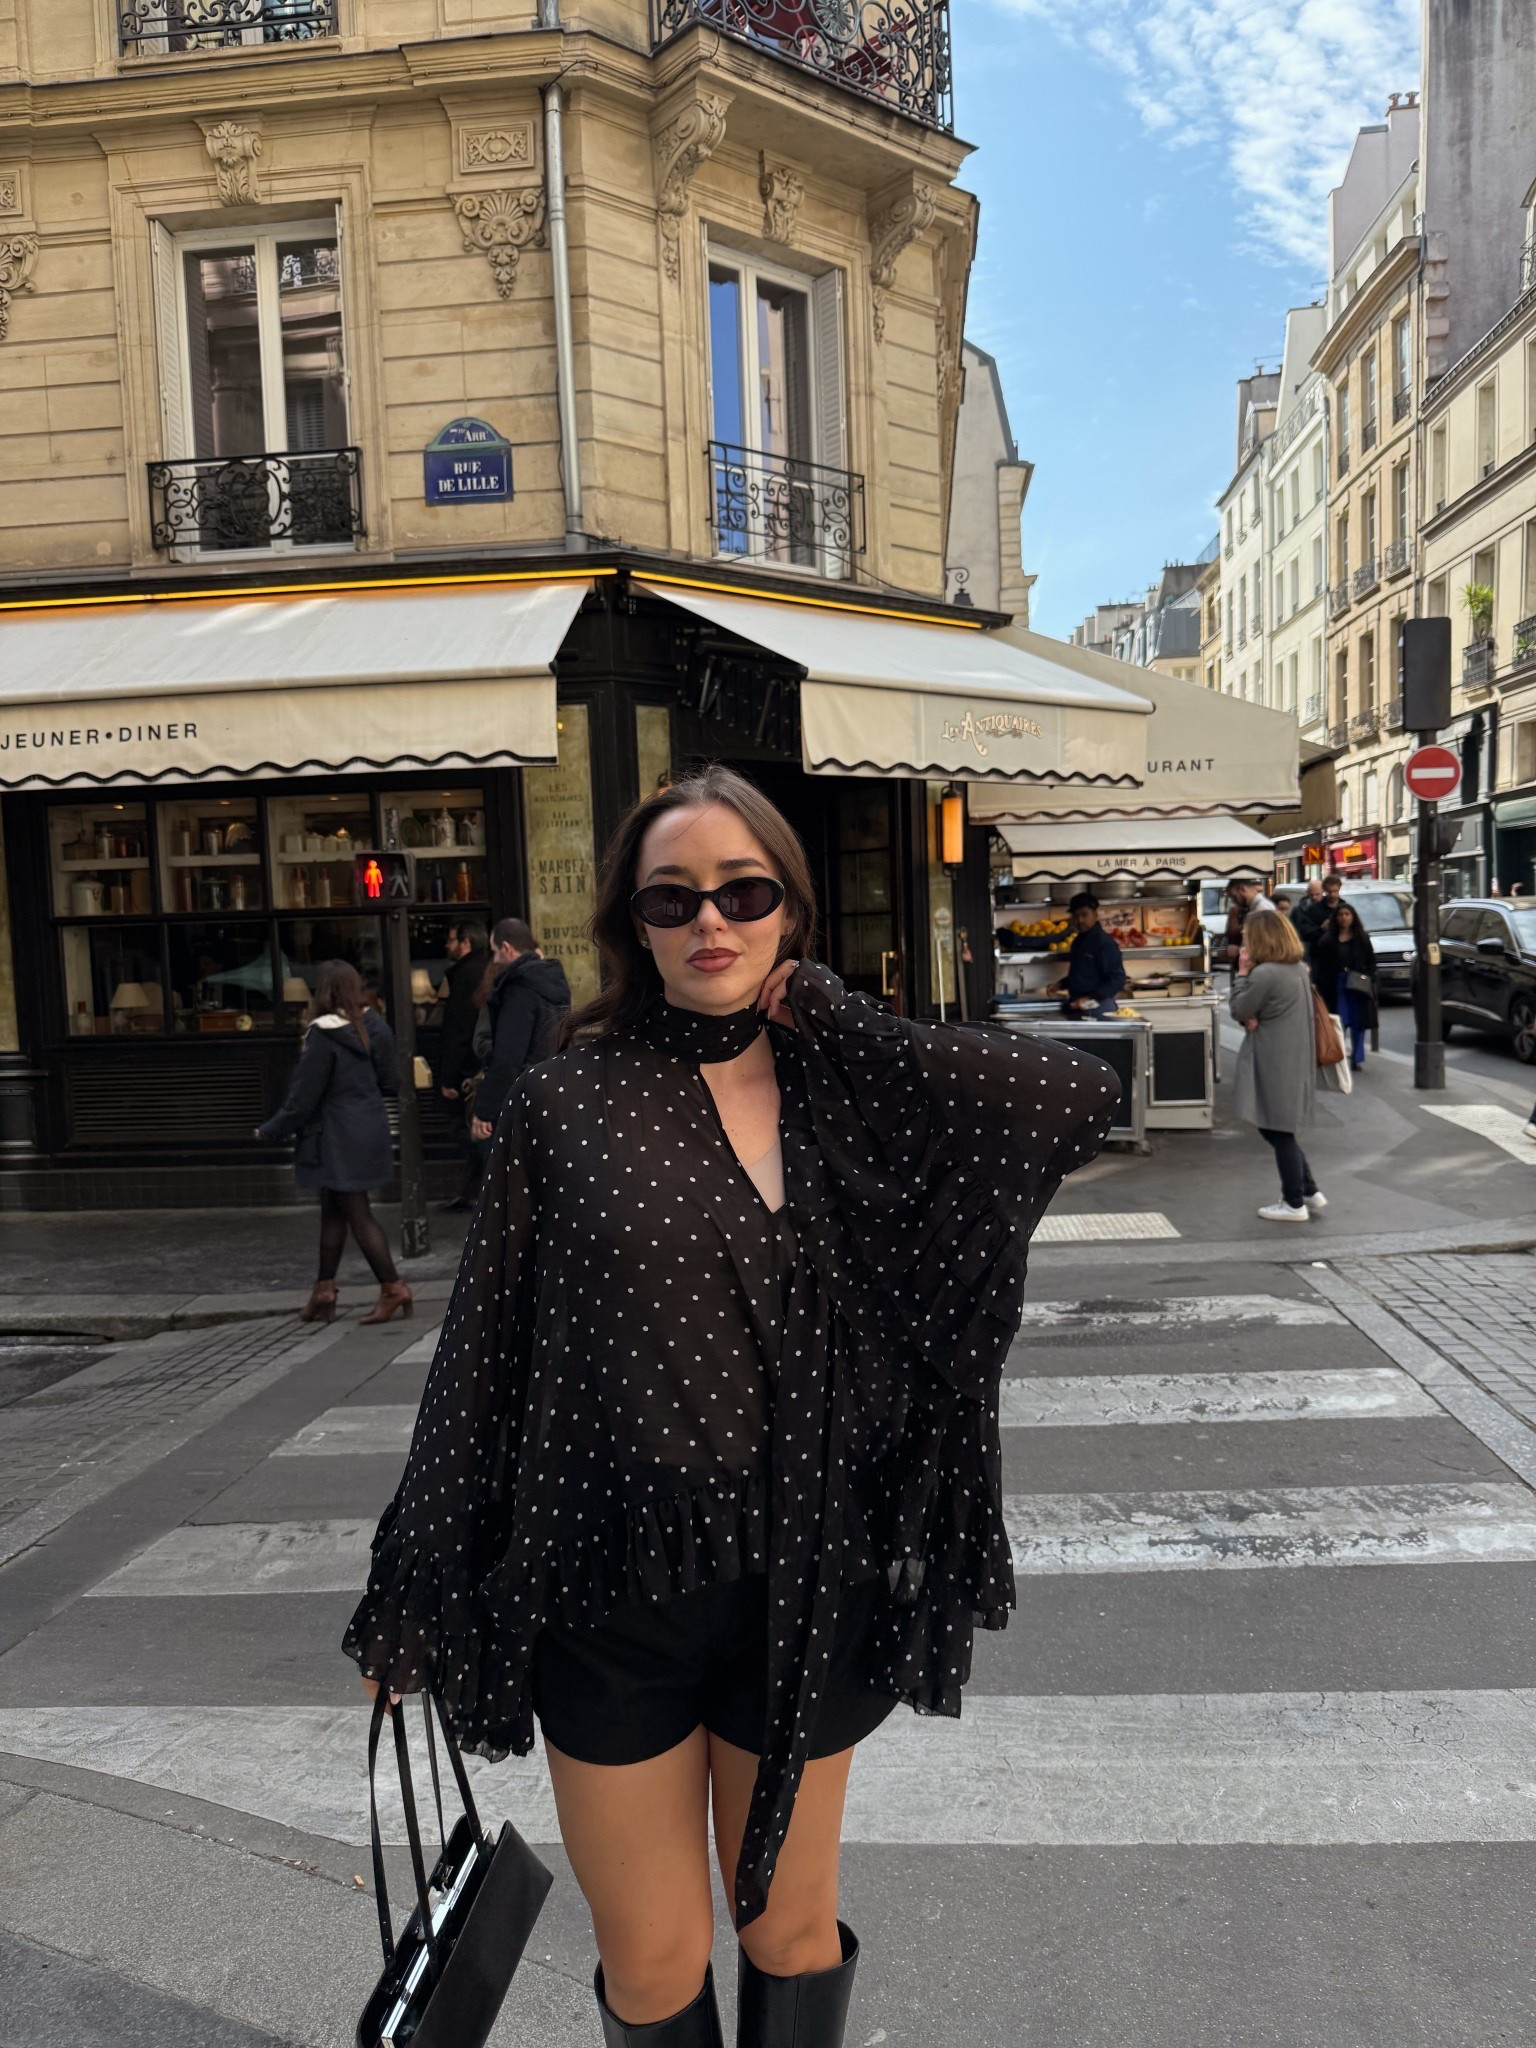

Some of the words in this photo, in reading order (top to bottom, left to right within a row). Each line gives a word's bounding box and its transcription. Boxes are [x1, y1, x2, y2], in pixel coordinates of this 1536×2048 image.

[454, 461, 481, 474] RUE
[438, 479, 456, 493] DE
[458, 476, 499, 491] LILLE
[1146, 758, 1215, 773] URANT
[1097, 859, 1110, 868] LA
[1114, 858, 1137, 868] MER
[1155, 857, 1186, 867] PARIS
[540, 875, 586, 895] SAIN
